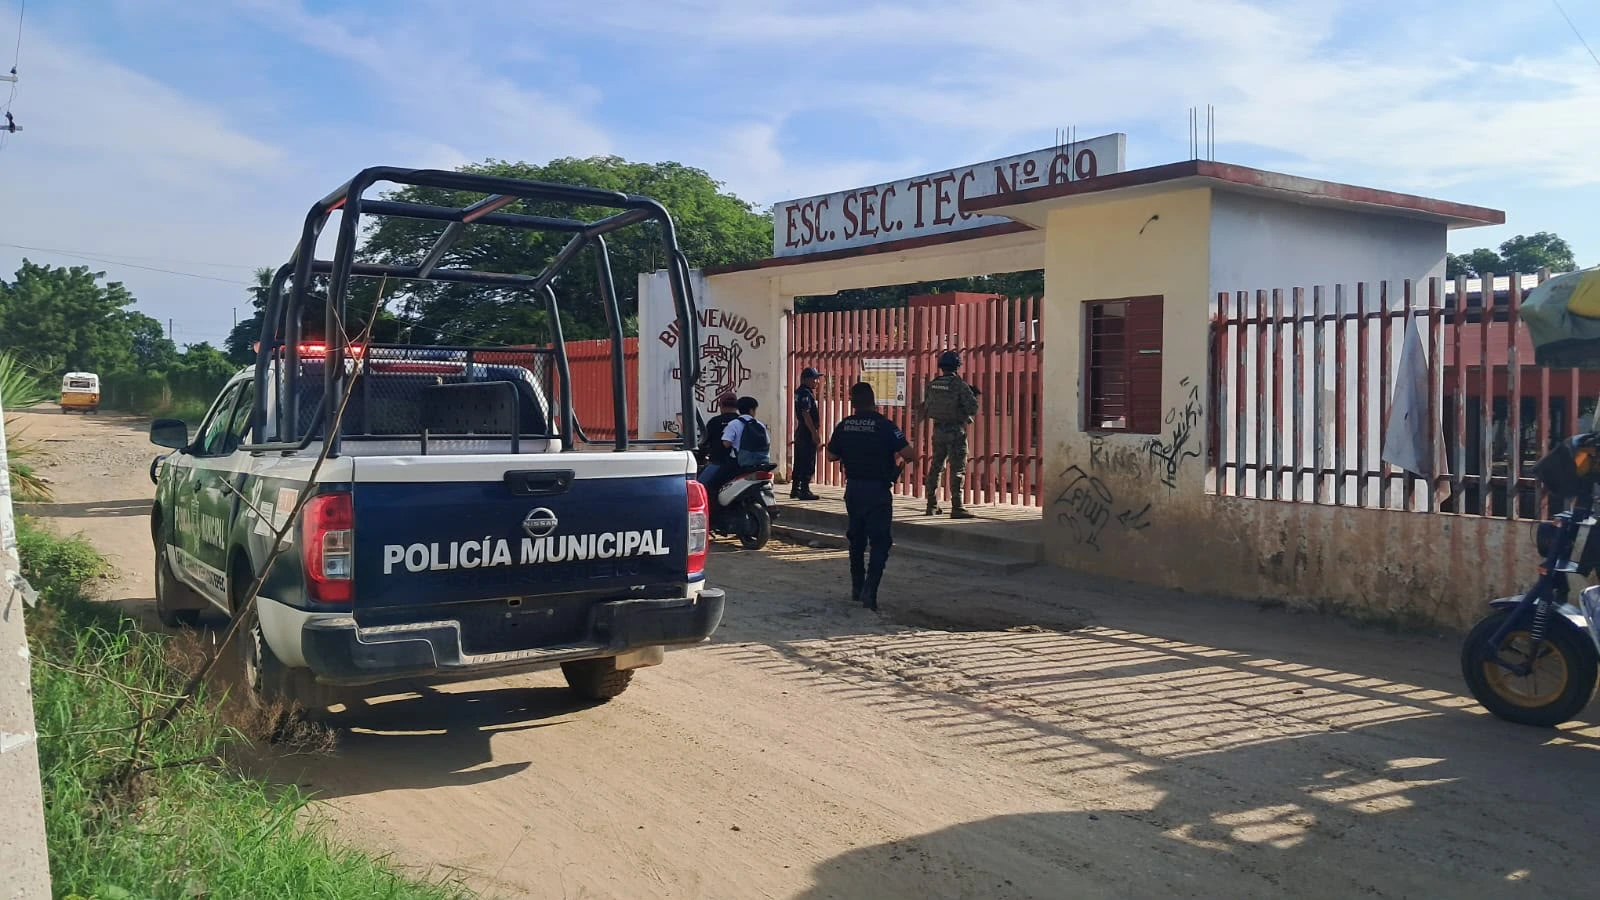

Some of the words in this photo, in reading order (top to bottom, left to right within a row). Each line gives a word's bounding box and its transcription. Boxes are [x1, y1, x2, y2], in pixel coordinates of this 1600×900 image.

[785, 200, 836, 249] ESC.
[842, 185, 904, 241] SEC.
[1049, 148, 1098, 186] 69
[658, 308, 766, 349] BIVENIDOS
[523, 519, 558, 527] NISSAN
[383, 536, 512, 575] POLICÍA
[519, 528, 670, 565] MUNICIPAL
